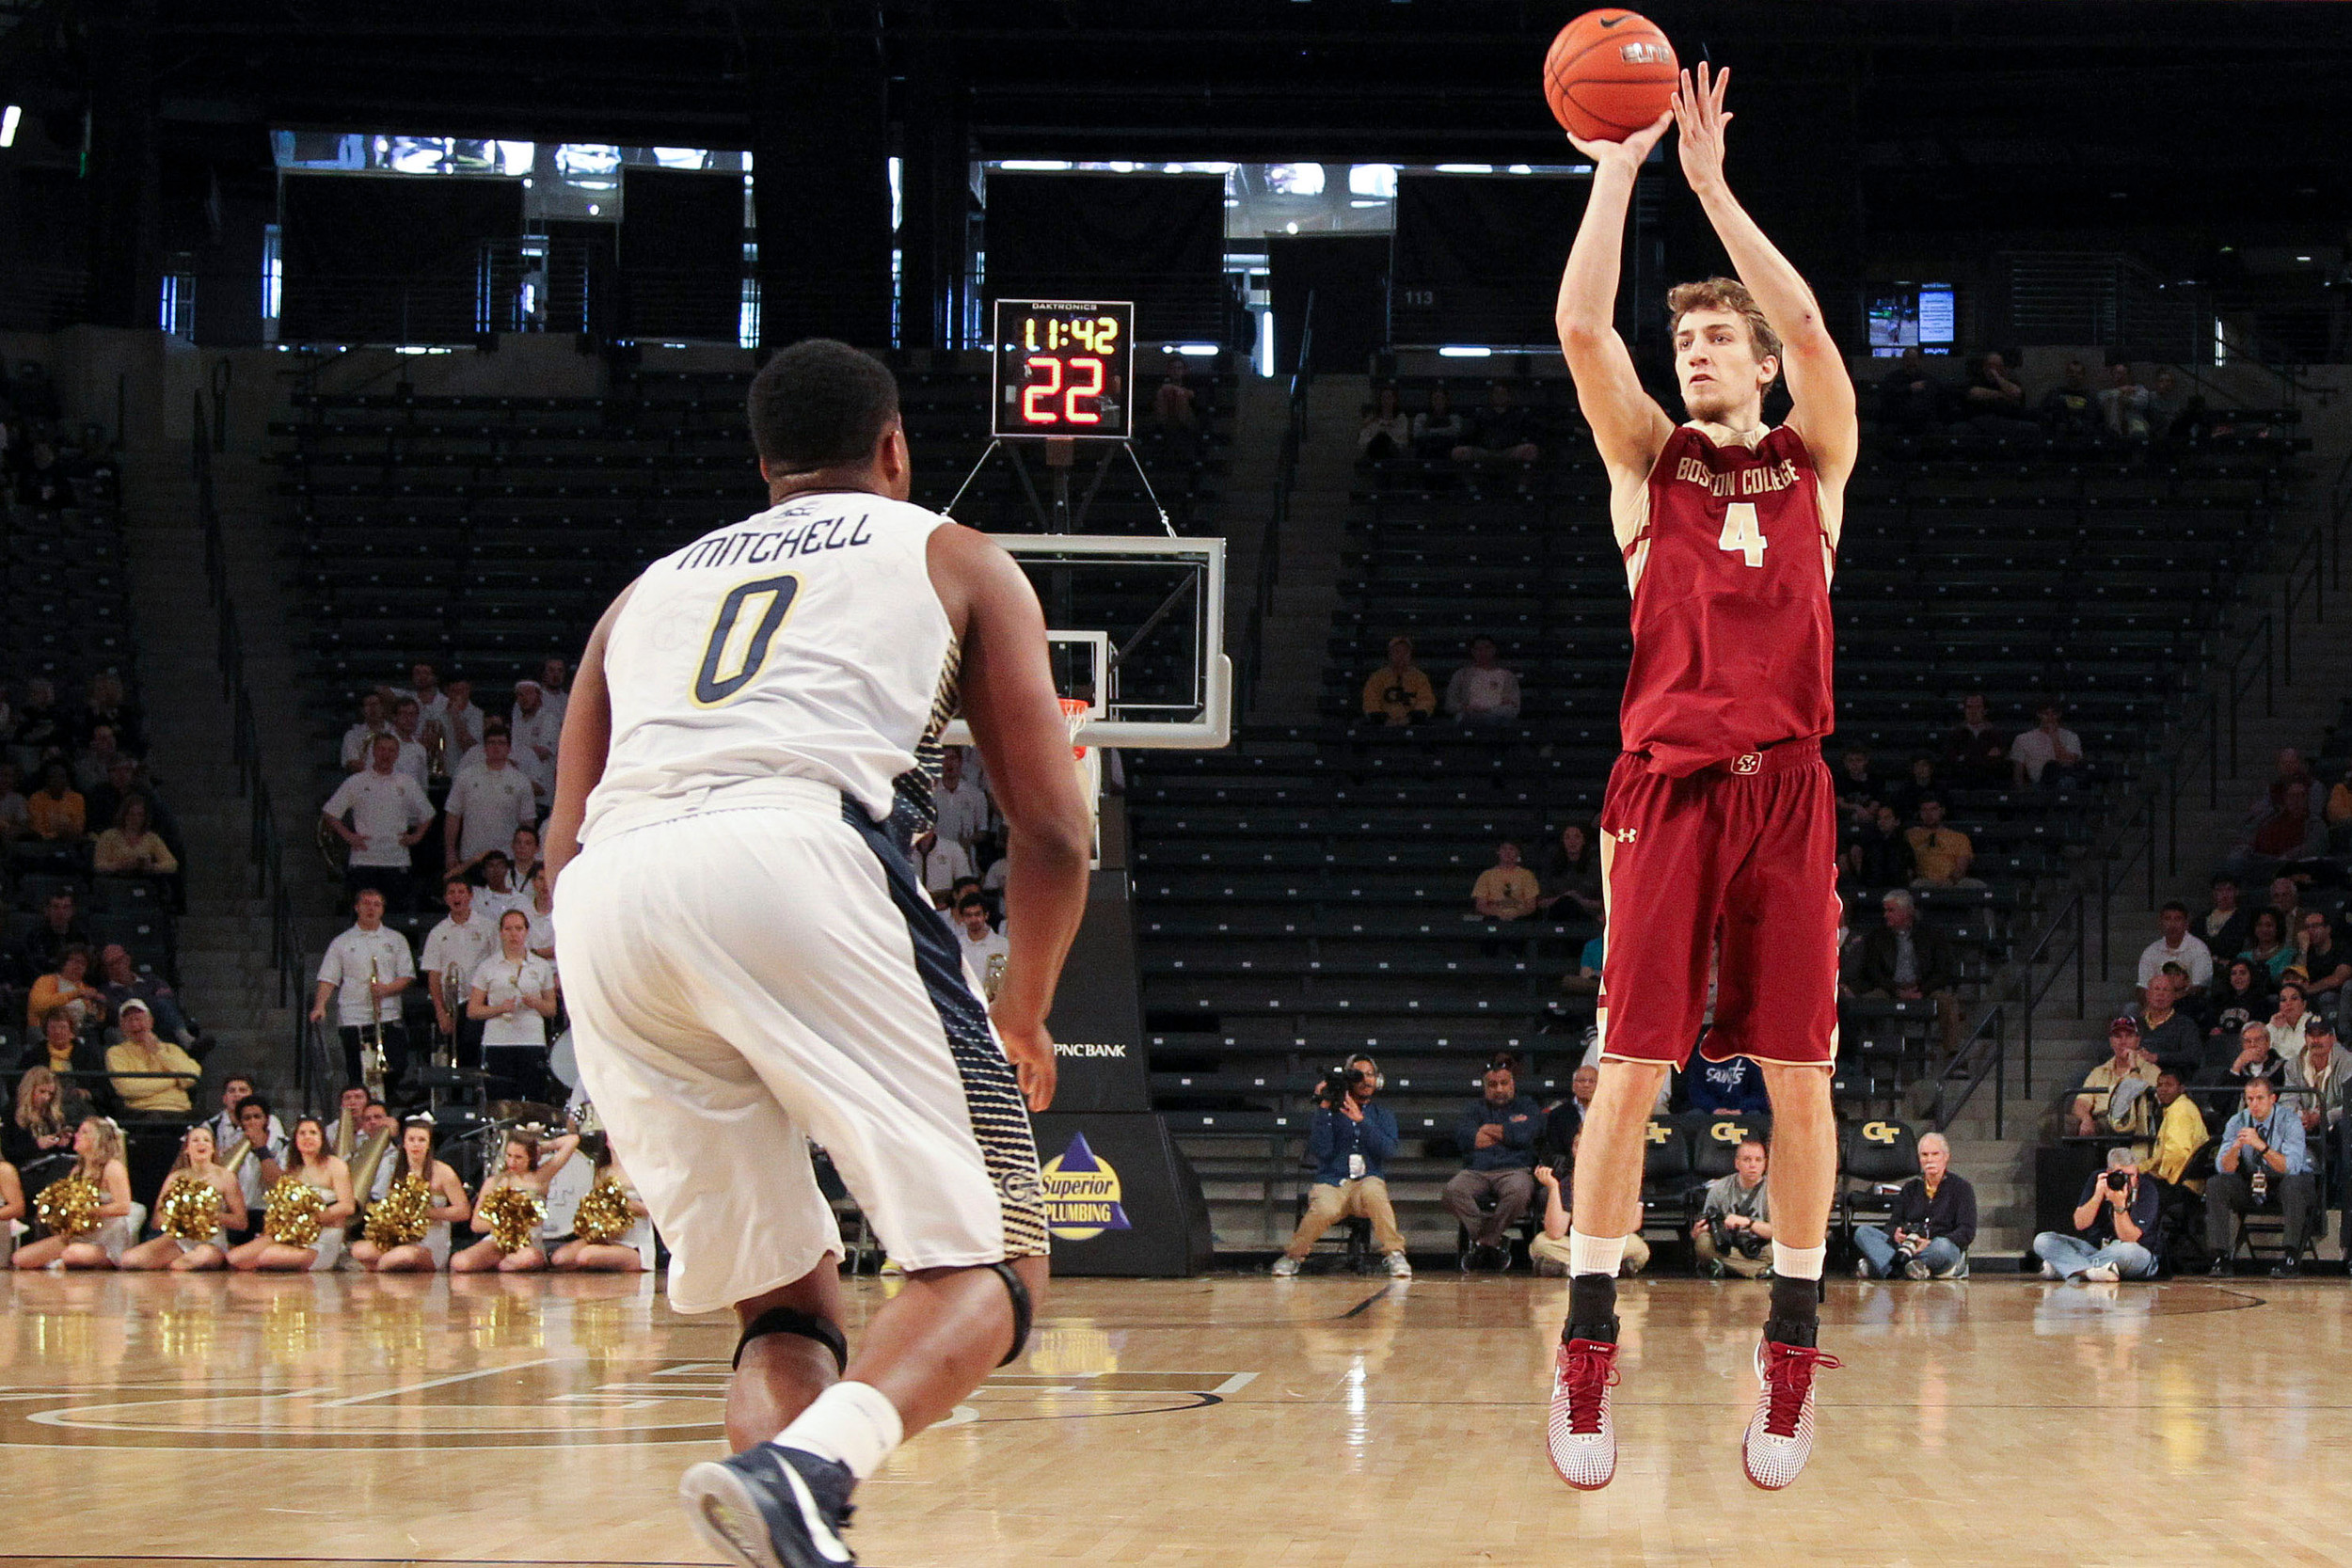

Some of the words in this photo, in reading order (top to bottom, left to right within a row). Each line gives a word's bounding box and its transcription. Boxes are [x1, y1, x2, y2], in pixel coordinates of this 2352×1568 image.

[1032, 302, 1098, 310] DAKTRONICS
[1025, 317, 1118, 355] 11:42
[1023, 356, 1106, 423] 22
[676, 514, 873, 570] MITCHELL
[1718, 502, 1768, 568] 4
[688, 570, 805, 710] 0
[1053, 1043, 1085, 1056] PNC
[1085, 1043, 1126, 1057] BANK
[1042, 1175, 1113, 1199] Superior
[1045, 1203, 1112, 1222] PLUMBING
